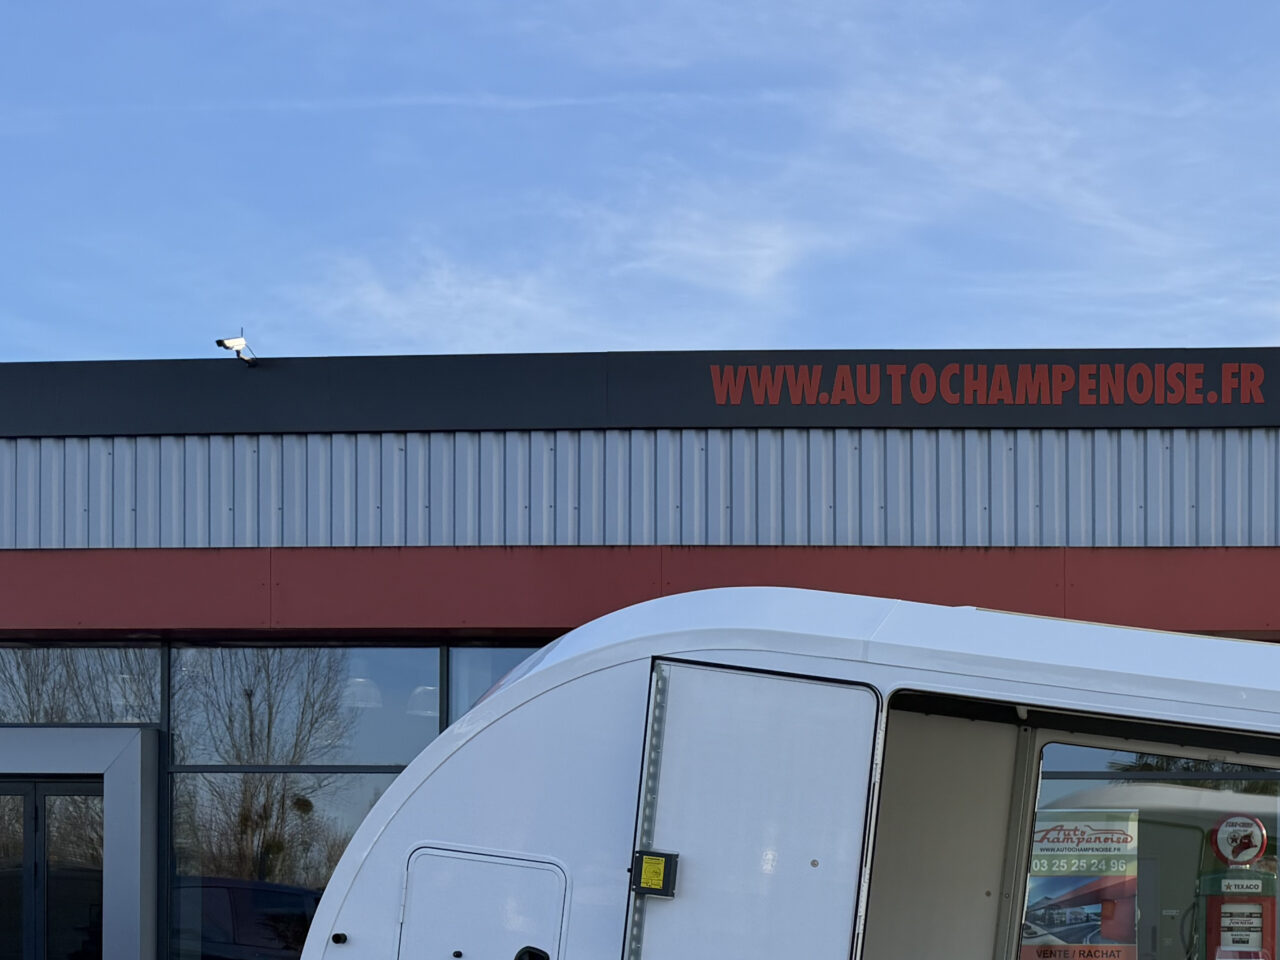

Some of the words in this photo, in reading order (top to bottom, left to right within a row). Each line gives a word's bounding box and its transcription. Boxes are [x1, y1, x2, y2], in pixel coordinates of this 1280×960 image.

[710, 362, 1266, 405] WWW.AUTOCHAMPENOISE.FR
[1032, 859, 1049, 871] 03
[1052, 859, 1068, 871] 25
[1071, 859, 1087, 871] 25
[1091, 859, 1106, 871] 24
[1110, 859, 1127, 871] 96
[1036, 949, 1070, 959] VENTE
[1079, 949, 1122, 959] RACHAT
